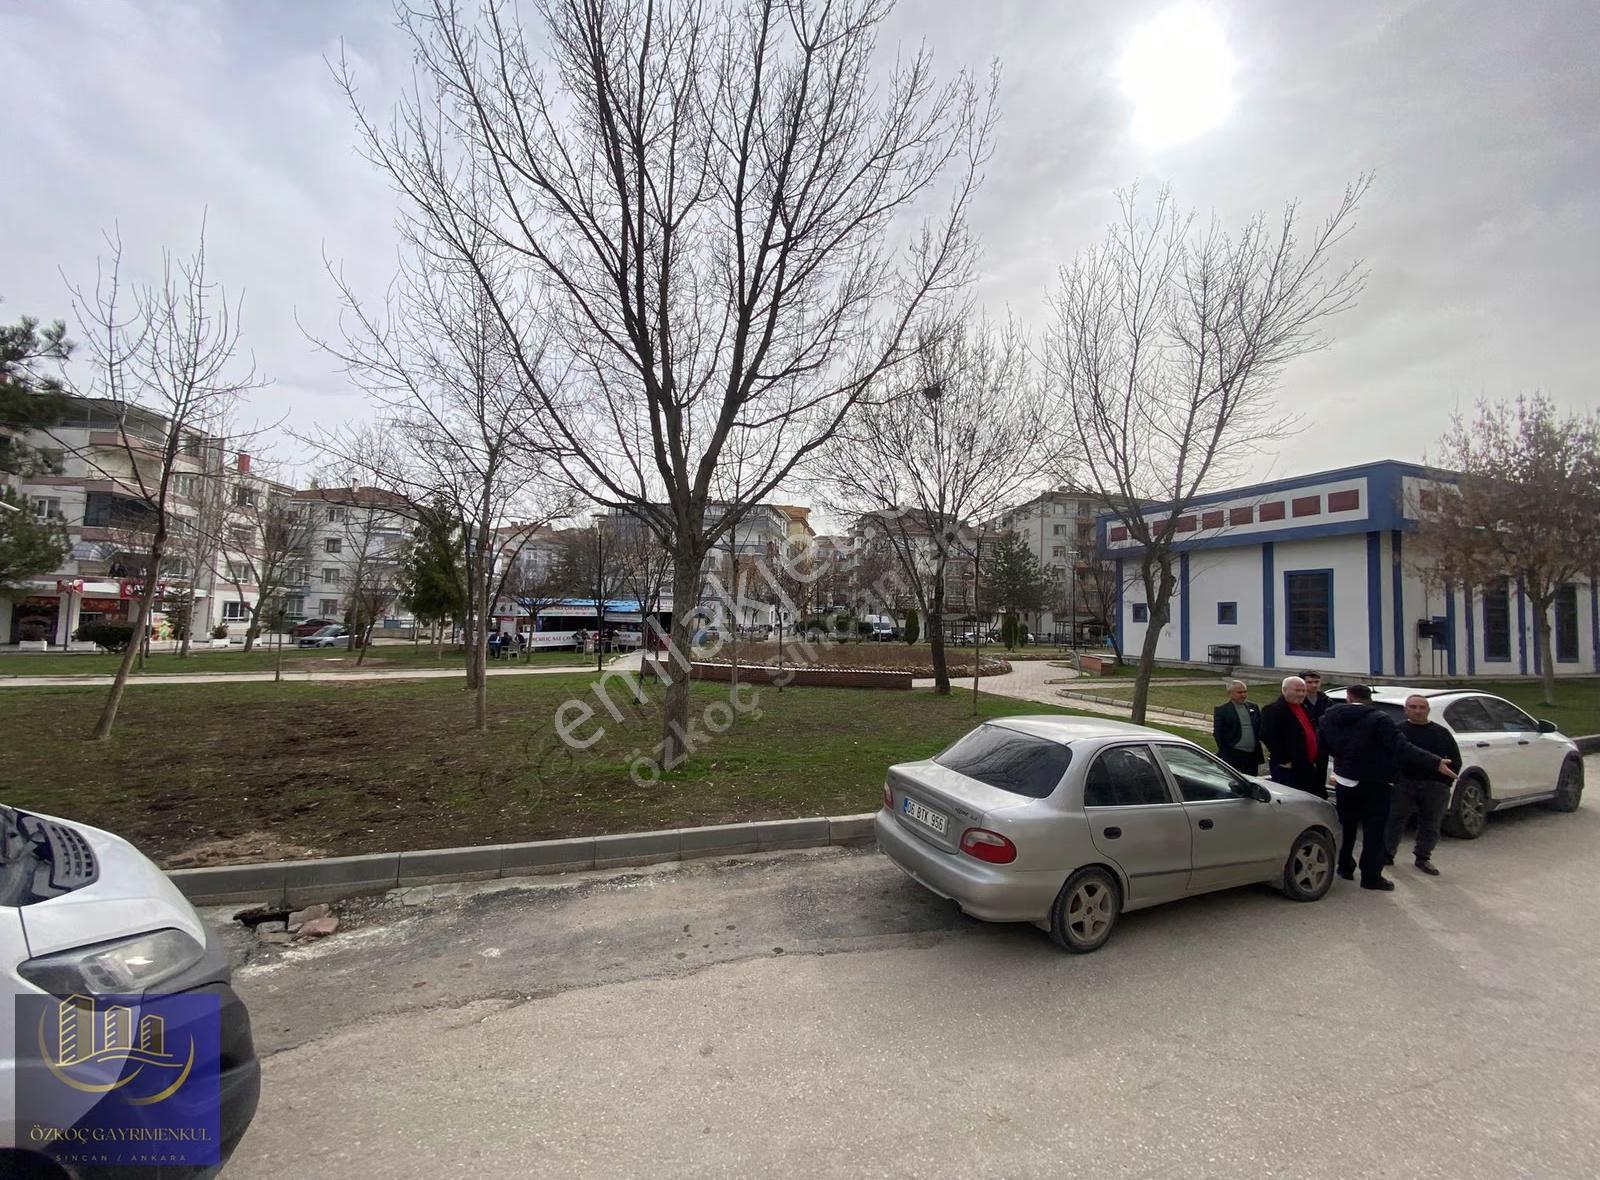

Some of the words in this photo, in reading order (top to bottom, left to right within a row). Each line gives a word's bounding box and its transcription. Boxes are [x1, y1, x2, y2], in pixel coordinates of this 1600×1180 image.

[907, 801, 915, 816] 06
[917, 806, 929, 822] BTK
[931, 813, 944, 831] 956
